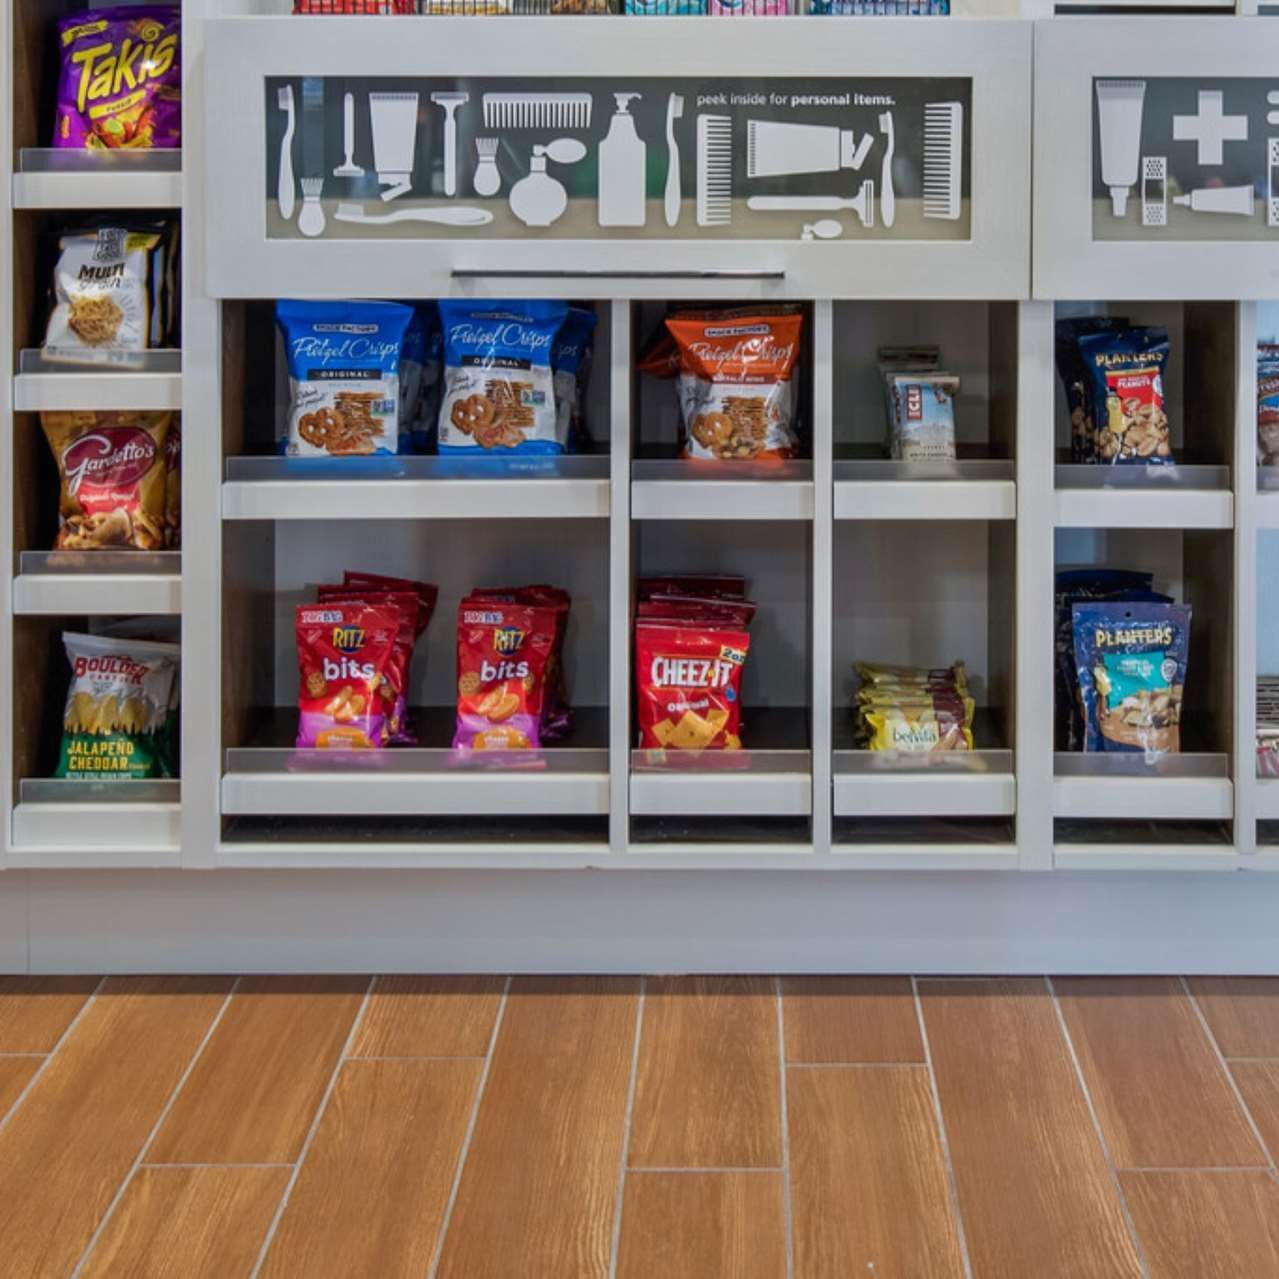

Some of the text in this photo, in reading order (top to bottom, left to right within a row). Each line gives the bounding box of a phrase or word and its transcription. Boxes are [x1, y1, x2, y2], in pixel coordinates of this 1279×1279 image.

[72, 34, 177, 113] Takis
[696, 93, 896, 107] peek inside for personal items.
[450, 323, 551, 351] Pretzel Crisps
[293, 336, 399, 365] Pretzel Crisps
[688, 341, 738, 366] Pretzel
[320, 370, 369, 378] ORIGINAL
[333, 629, 365, 648] RITZ
[494, 630, 524, 650] RITZ
[1095, 627, 1172, 647] PLANTERS
[74, 656, 149, 686] BOULDER
[324, 657, 375, 680] bits
[481, 660, 529, 682] bits
[69, 757, 129, 770] CHEDDAR
